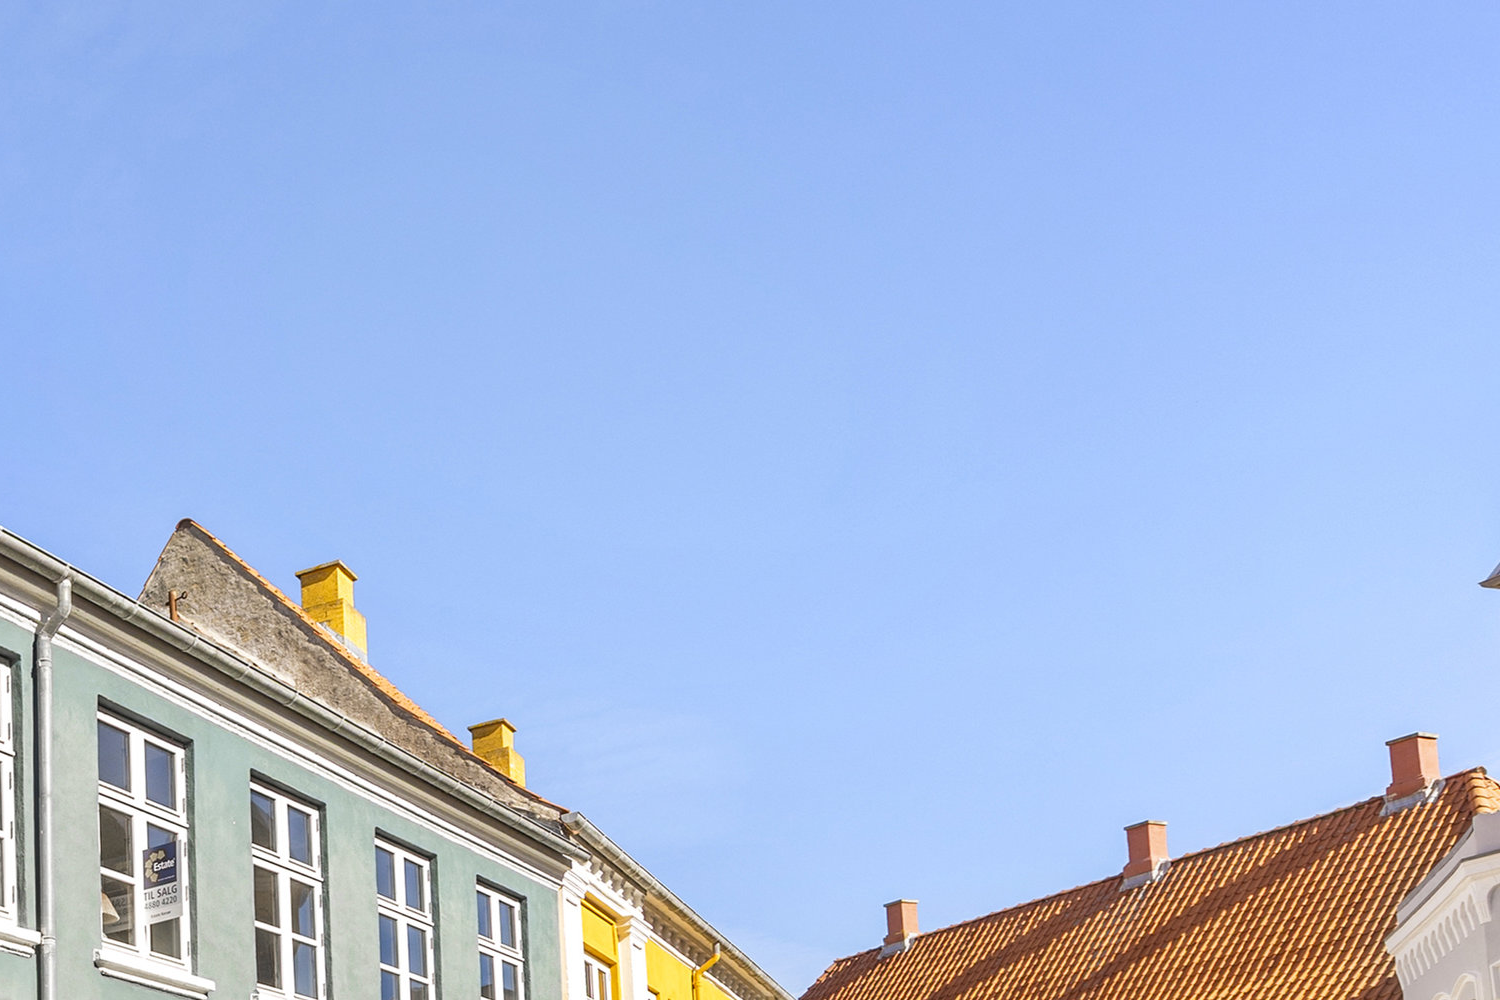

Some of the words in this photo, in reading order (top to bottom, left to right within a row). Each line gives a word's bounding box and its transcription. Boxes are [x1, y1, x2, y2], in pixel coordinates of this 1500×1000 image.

[153, 859, 175, 872] Estate
[144, 890, 154, 901] TIL
[157, 884, 178, 898] SALG
[161, 895, 178, 905] 4220
